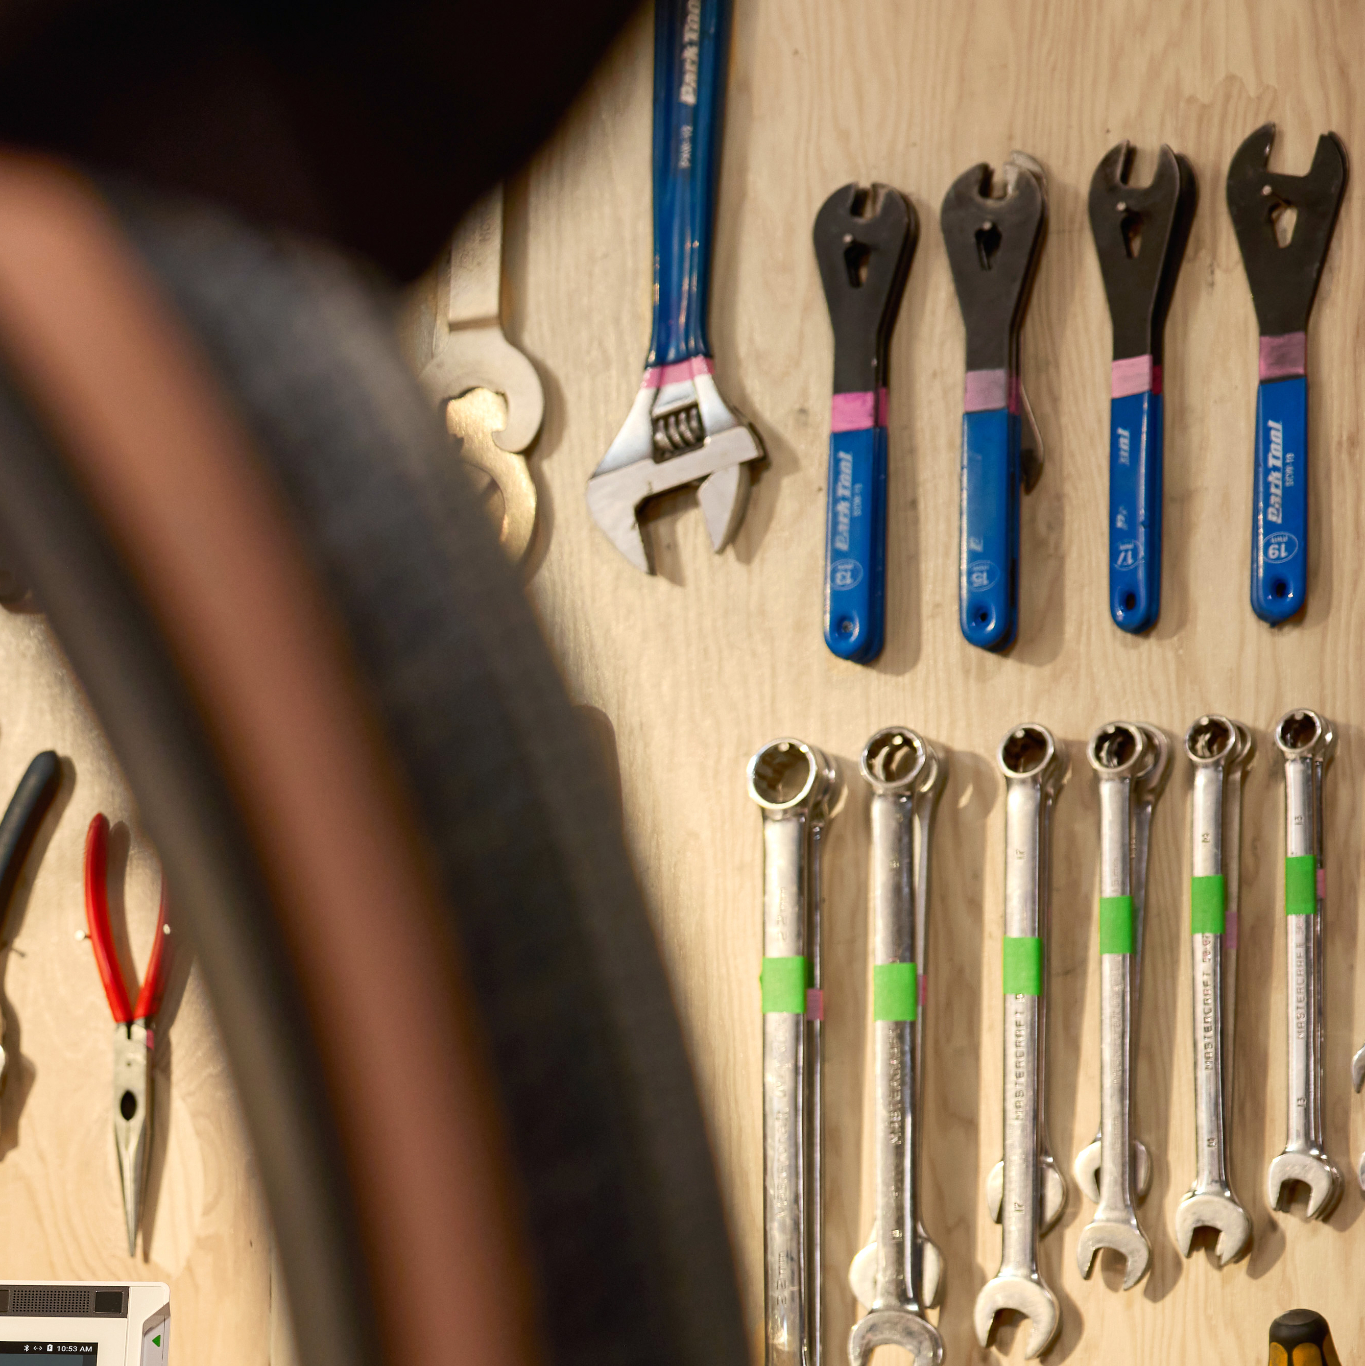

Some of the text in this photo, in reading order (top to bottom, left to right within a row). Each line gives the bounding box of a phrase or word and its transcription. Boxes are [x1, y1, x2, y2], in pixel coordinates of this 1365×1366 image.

[680, 0, 701, 105] Park Too
[834, 450, 853, 551] Park Tool
[1266, 418, 1282, 525] Park Tool
[834, 571, 853, 586] 13
[971, 572, 990, 587] 15
[1116, 550, 1134, 566] 17
[1266, 543, 1289, 560] 19
[1014, 1010, 1026, 1122] MASTERCRAFT
[1202, 971, 1214, 1071] MASTERCRAFT
